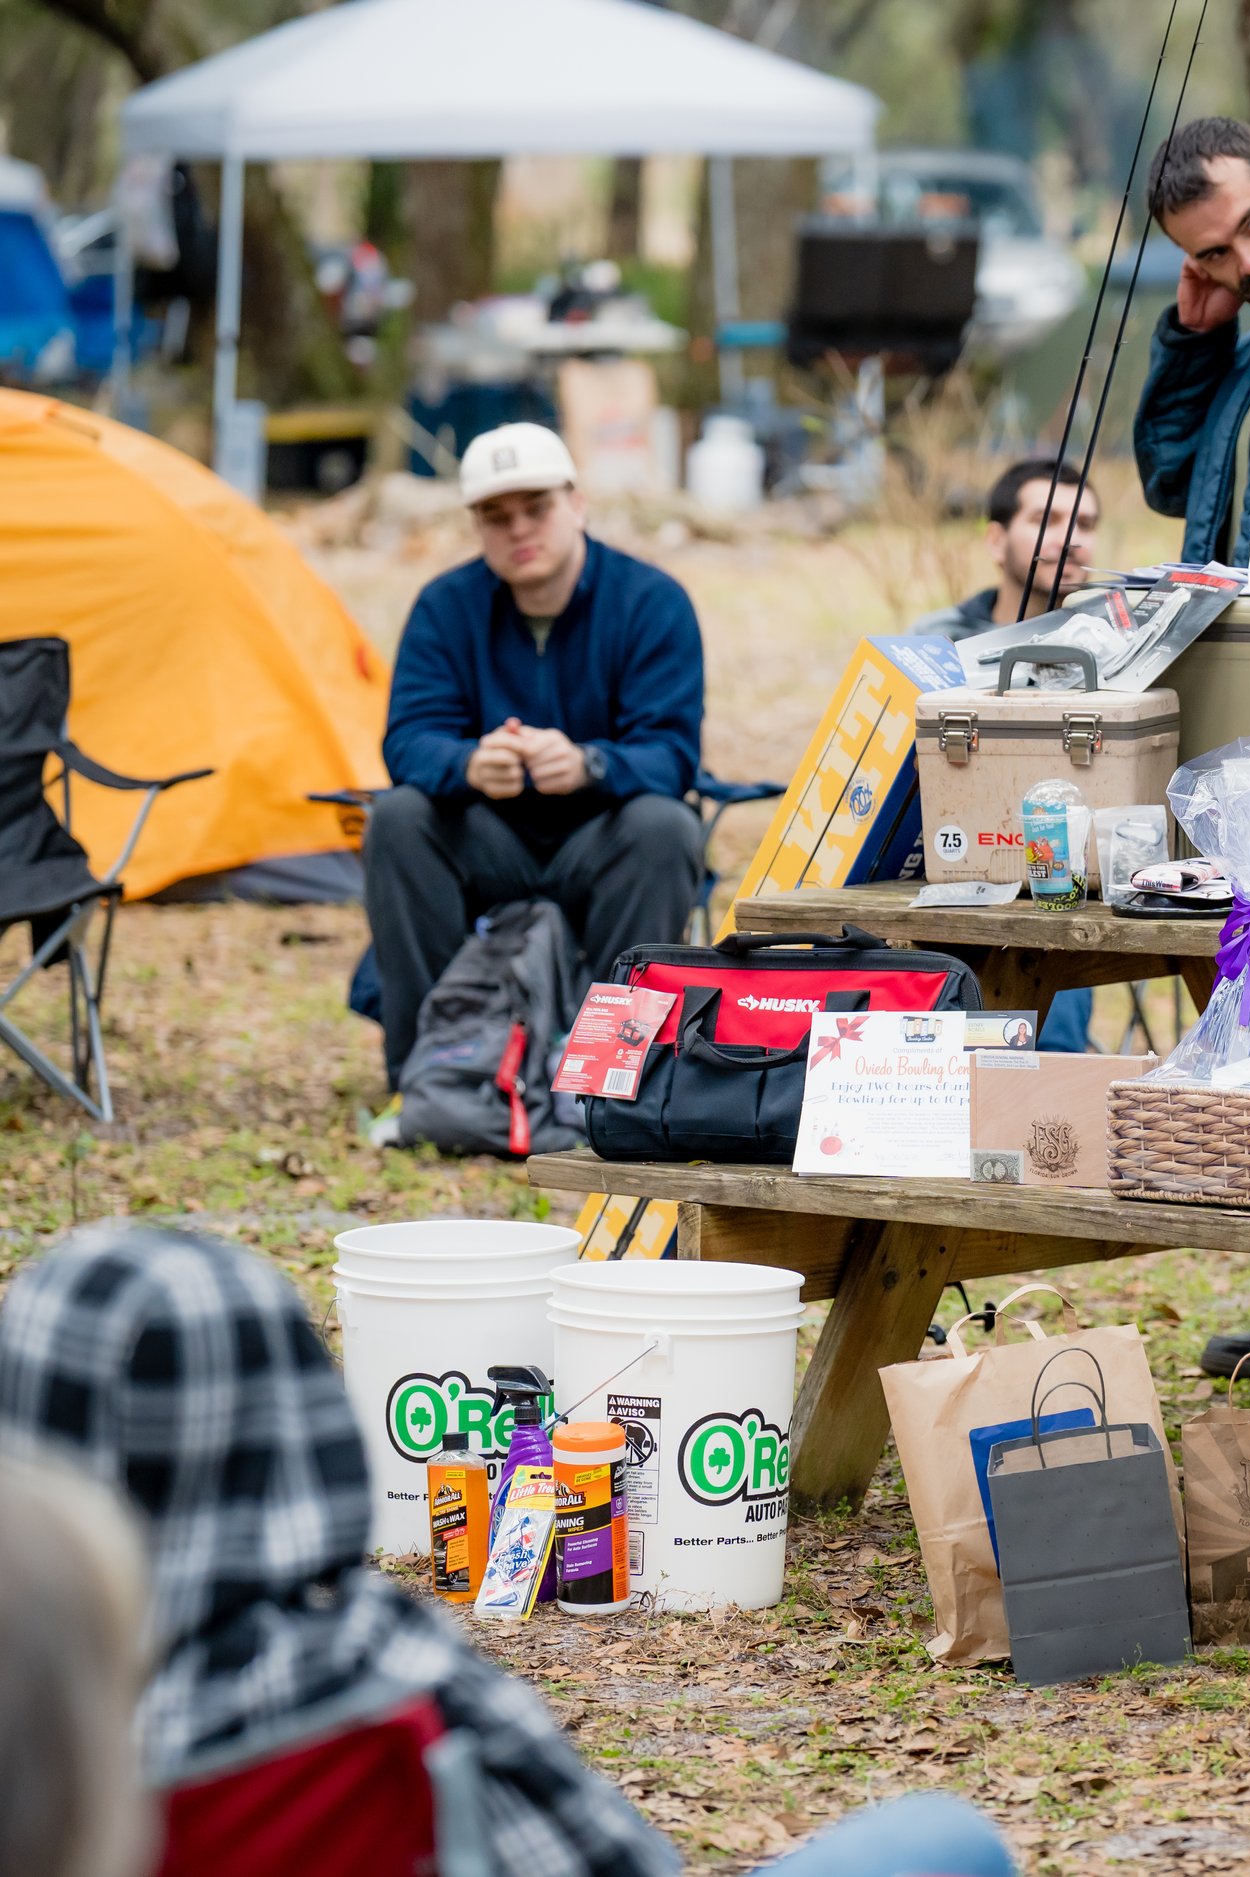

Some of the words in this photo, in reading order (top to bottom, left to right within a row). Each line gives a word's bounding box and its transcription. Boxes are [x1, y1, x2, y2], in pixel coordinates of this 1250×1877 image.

[940, 833, 962, 848] 7.5
[600, 995, 633, 1006] HUSKY
[759, 997, 816, 1013] HUSKY
[893, 1047, 933, 1055] Compliments
[855, 1055, 893, 1076] Oviedo
[897, 1055, 944, 1083] Bowling
[831, 1081, 863, 1093] Enjoy
[868, 1081, 893, 1091] TWO
[897, 1081, 932, 1091] hours
[935, 1081, 948, 1091] of
[838, 1095, 885, 1107] Bowling
[889, 1094, 907, 1105] for
[909, 1096, 924, 1107] up
[929, 1095, 939, 1104] to
[1029, 1168, 1049, 1179] FLORIDA
[1061, 1168, 1079, 1179] GROWN
[616, 1397, 660, 1408] WARNING
[395, 1383, 554, 1452] O'Re
[616, 1407, 645, 1417] AVISO
[387, 1491, 420, 1501] Better
[510, 1485, 536, 1500] Little
[449, 1512, 465, 1523] WAX
[744, 1501, 776, 1523] AUTO
[582, 1537, 599, 1545] Cleaning
[674, 1537, 713, 1546] Better
[716, 1535, 754, 1545] Parts...
[756, 1530, 779, 1542] Better
[498, 1550, 528, 1562] Fresh
[497, 1557, 528, 1572] Shave
